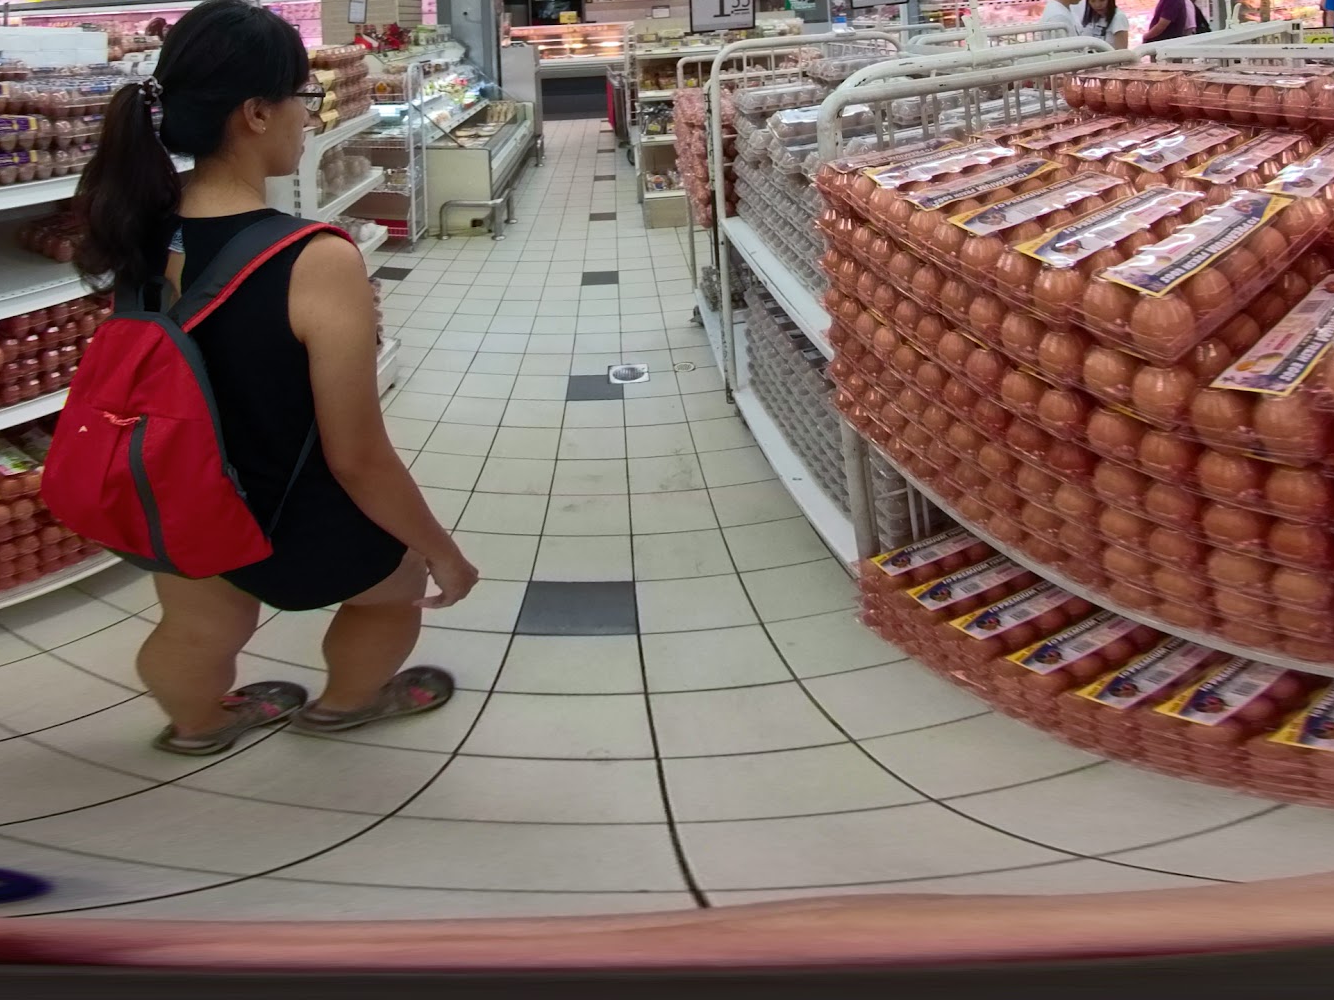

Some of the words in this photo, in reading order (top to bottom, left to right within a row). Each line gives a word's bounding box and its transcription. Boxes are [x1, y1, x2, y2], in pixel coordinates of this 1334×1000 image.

[1003, 187, 1050, 207] PREMIUM
[1074, 207, 1118, 227] PREMIUM
[1206, 222, 1249, 254] PREMIUM
[913, 534, 948, 551] PREMIUM
[952, 563, 988, 581] PREMIUM
[998, 588, 1037, 609] PREMIUM
[1056, 619, 1099, 641] PREMIUM
[1130, 647, 1167, 672] PREMIUM
[1212, 657, 1248, 684] PREMIUM
